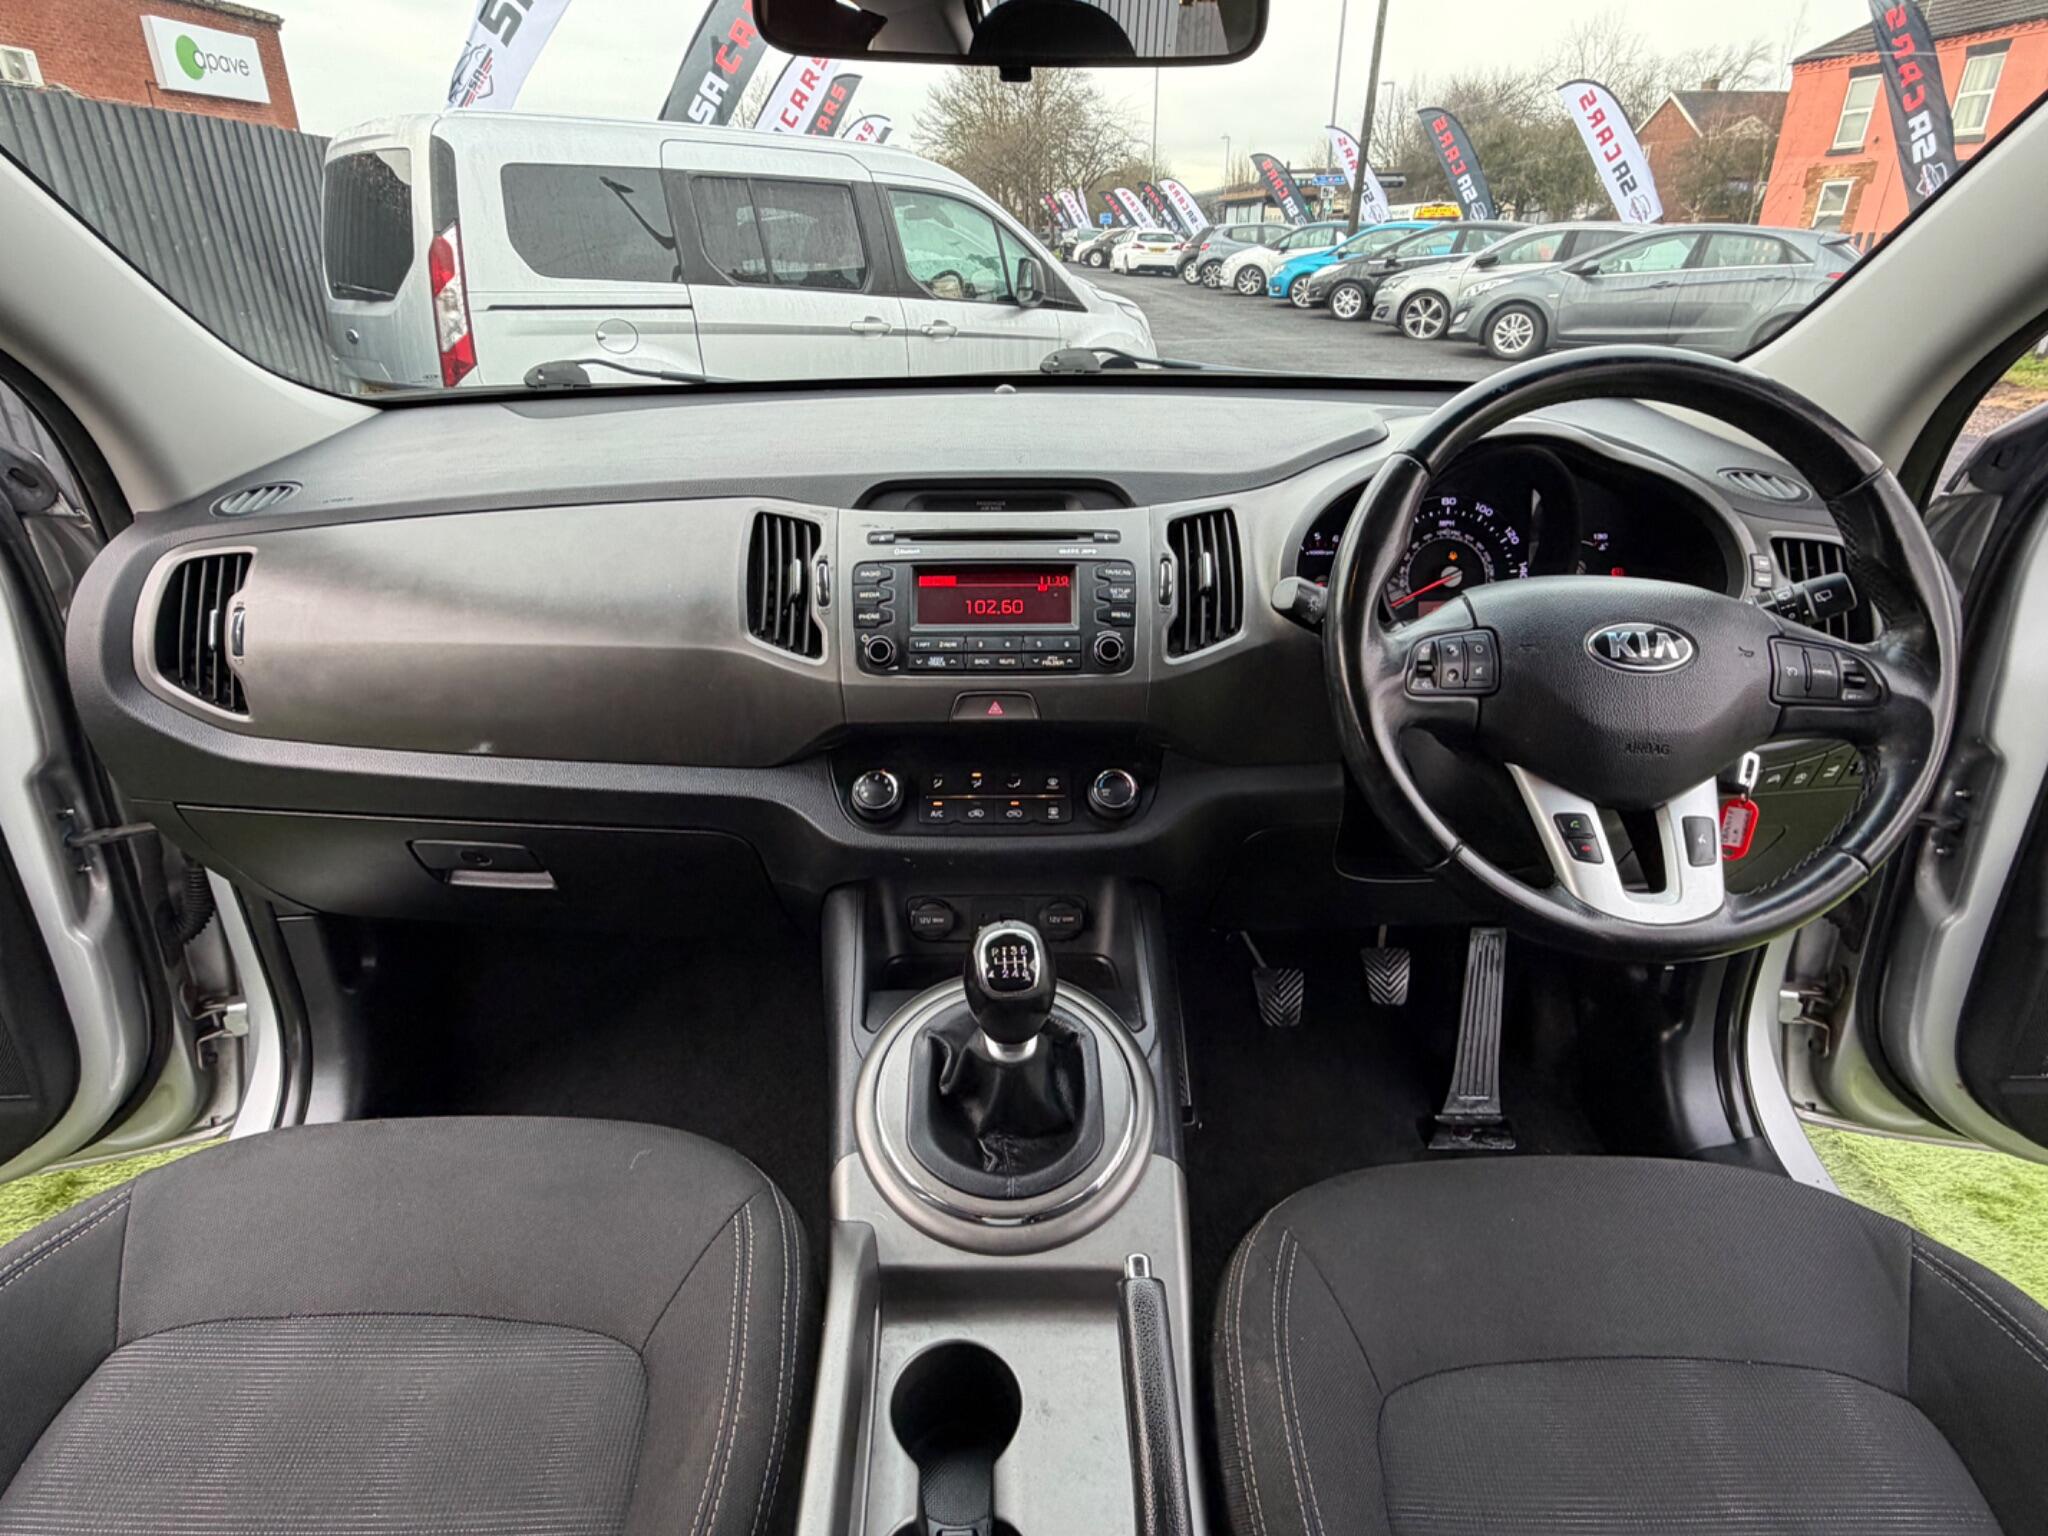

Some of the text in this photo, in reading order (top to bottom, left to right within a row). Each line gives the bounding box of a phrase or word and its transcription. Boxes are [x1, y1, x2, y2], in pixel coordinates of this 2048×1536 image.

[478, 0, 534, 47] S
[193, 50, 250, 77] apave
[688, 0, 757, 124] SA CA
[811, 83, 848, 135] ARS
[1475, 502, 1494, 517] 100
[1505, 526, 1519, 544] 120
[859, 591, 880, 599] MEDIA
[966, 599, 1024, 616] 102.60
[1605, 631, 1680, 659] KIA
[974, 657, 990, 665] BACK
[999, 657, 1015, 665] MUTE
[1624, 743, 1671, 755] AIRBAG
[930, 810, 944, 818] A/C
[1010, 945, 1017, 955] 3
[1002, 970, 1009, 979] 2
